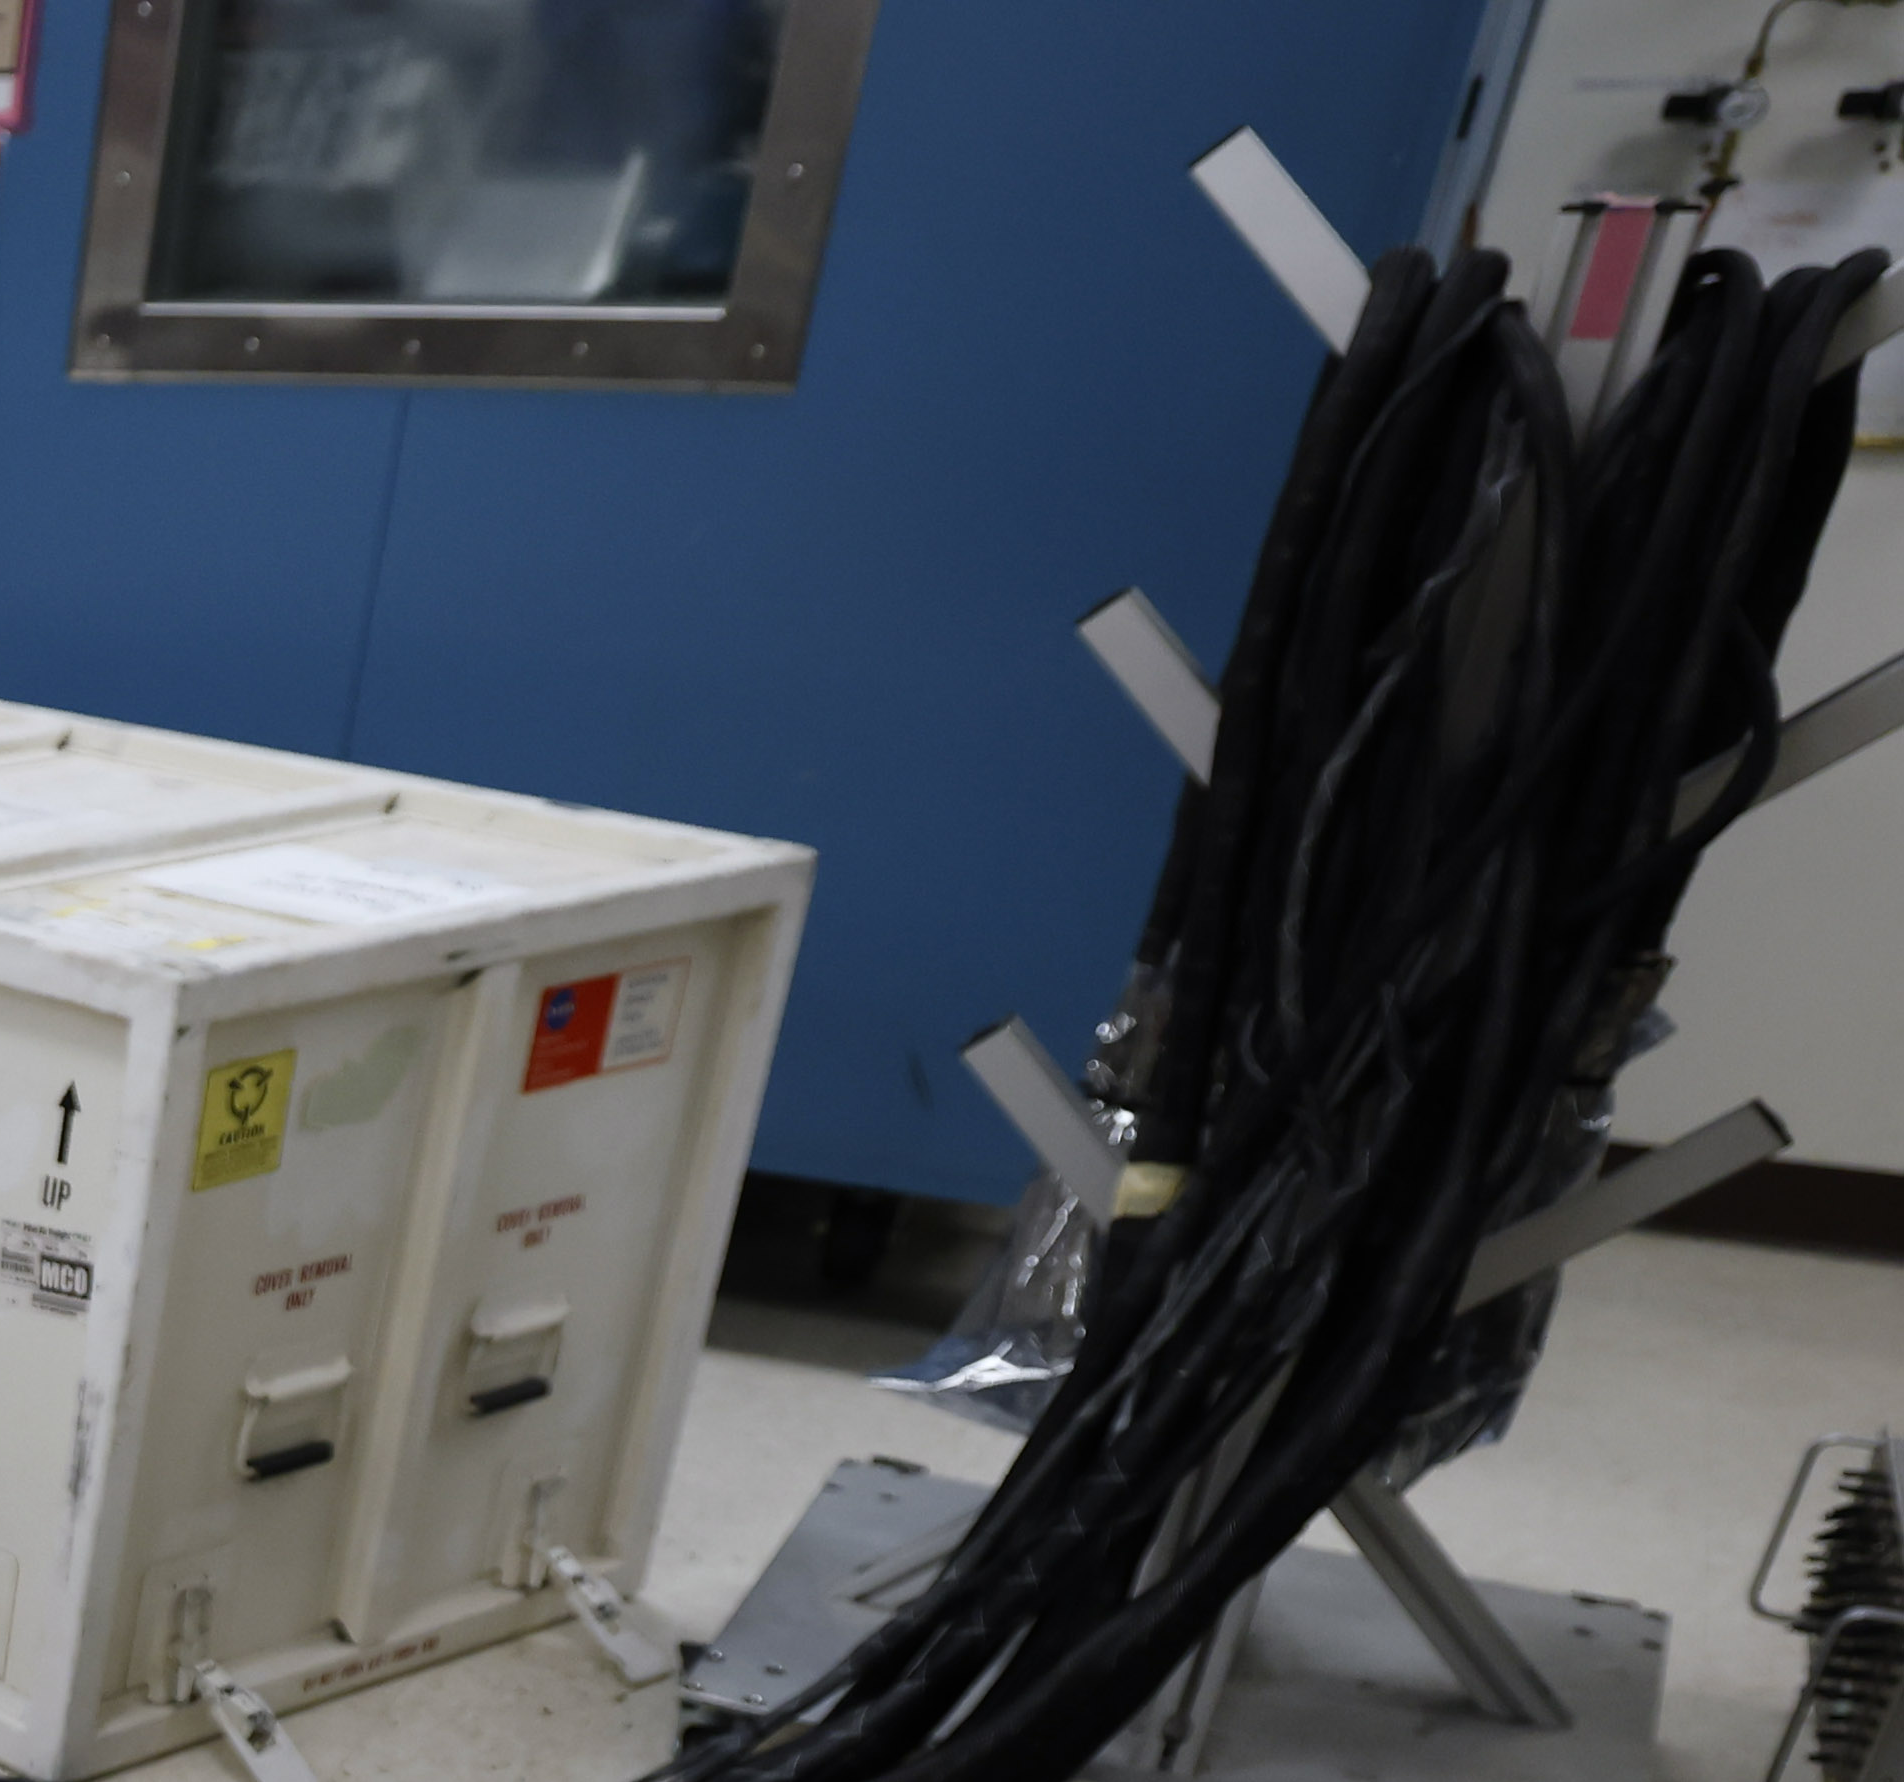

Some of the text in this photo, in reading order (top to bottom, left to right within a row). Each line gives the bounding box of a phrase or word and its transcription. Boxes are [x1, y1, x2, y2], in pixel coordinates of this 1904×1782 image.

[219, 1124, 266, 1147] CAUTION
[42, 1175, 72, 1211] UP
[41, 1259, 88, 1296] MCO
[253, 1269, 293, 1297] COVER
